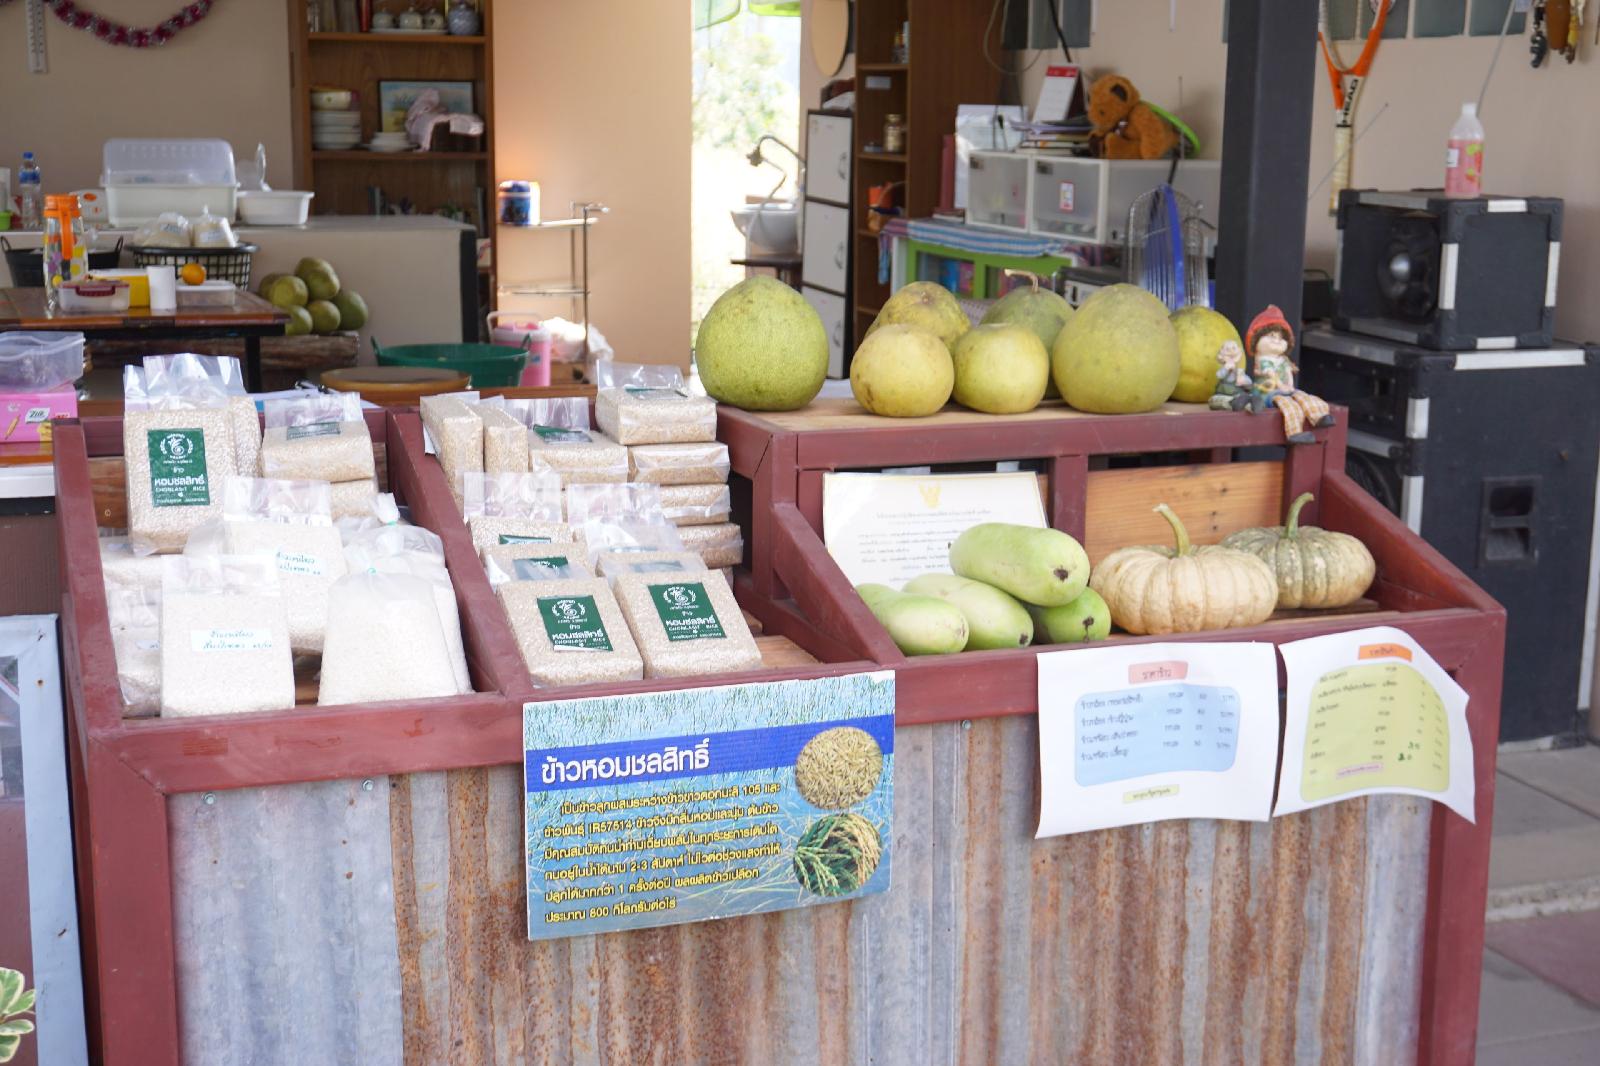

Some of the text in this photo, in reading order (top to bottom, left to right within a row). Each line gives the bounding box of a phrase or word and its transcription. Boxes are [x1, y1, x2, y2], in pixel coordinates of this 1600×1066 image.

[1342, 78, 1359, 124] HEAD
[154, 474, 206, 486] หอมชลสิทธิ์
[542, 739, 710, 783] ข้าวหอมชลสิทธิ์
[742, 785, 761, 796] 105
[764, 783, 781, 793] และ
[543, 822, 586, 838] ข้าวพันธุ์
[747, 802, 780, 816] ต้นข้าว
[630, 859, 648, 873] 2-3
[651, 854, 685, 871] สัปดาห์
[544, 883, 615, 904] ปลูกได้มากกว่า
[617, 883, 625, 895] 1
[628, 876, 672, 894] ครั้งต่อปี
[545, 896, 677, 924] ประมาณ 800 กิโลกรัมต่อไร่
